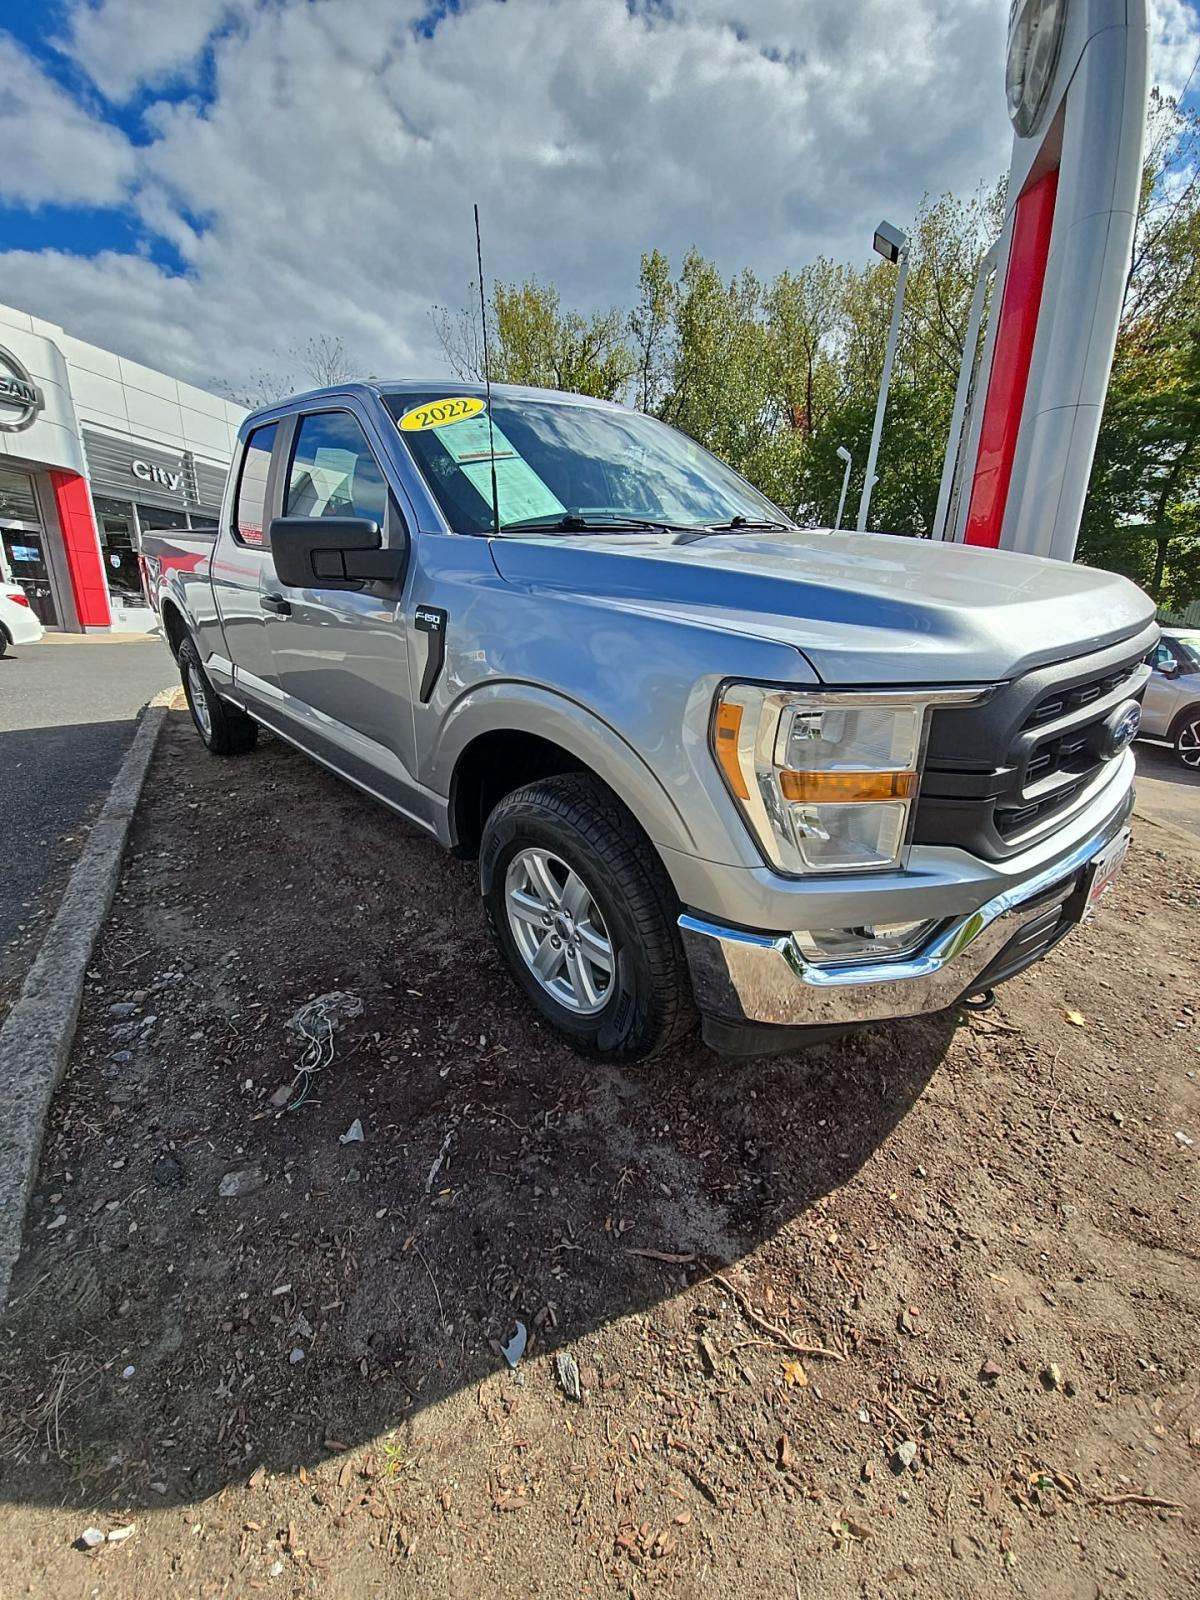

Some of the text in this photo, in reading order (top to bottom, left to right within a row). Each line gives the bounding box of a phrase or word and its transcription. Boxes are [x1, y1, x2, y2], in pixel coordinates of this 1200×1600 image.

[416, 400, 473, 427] 2022
[131, 460, 179, 491] City
[415, 611, 440, 624] F-150
